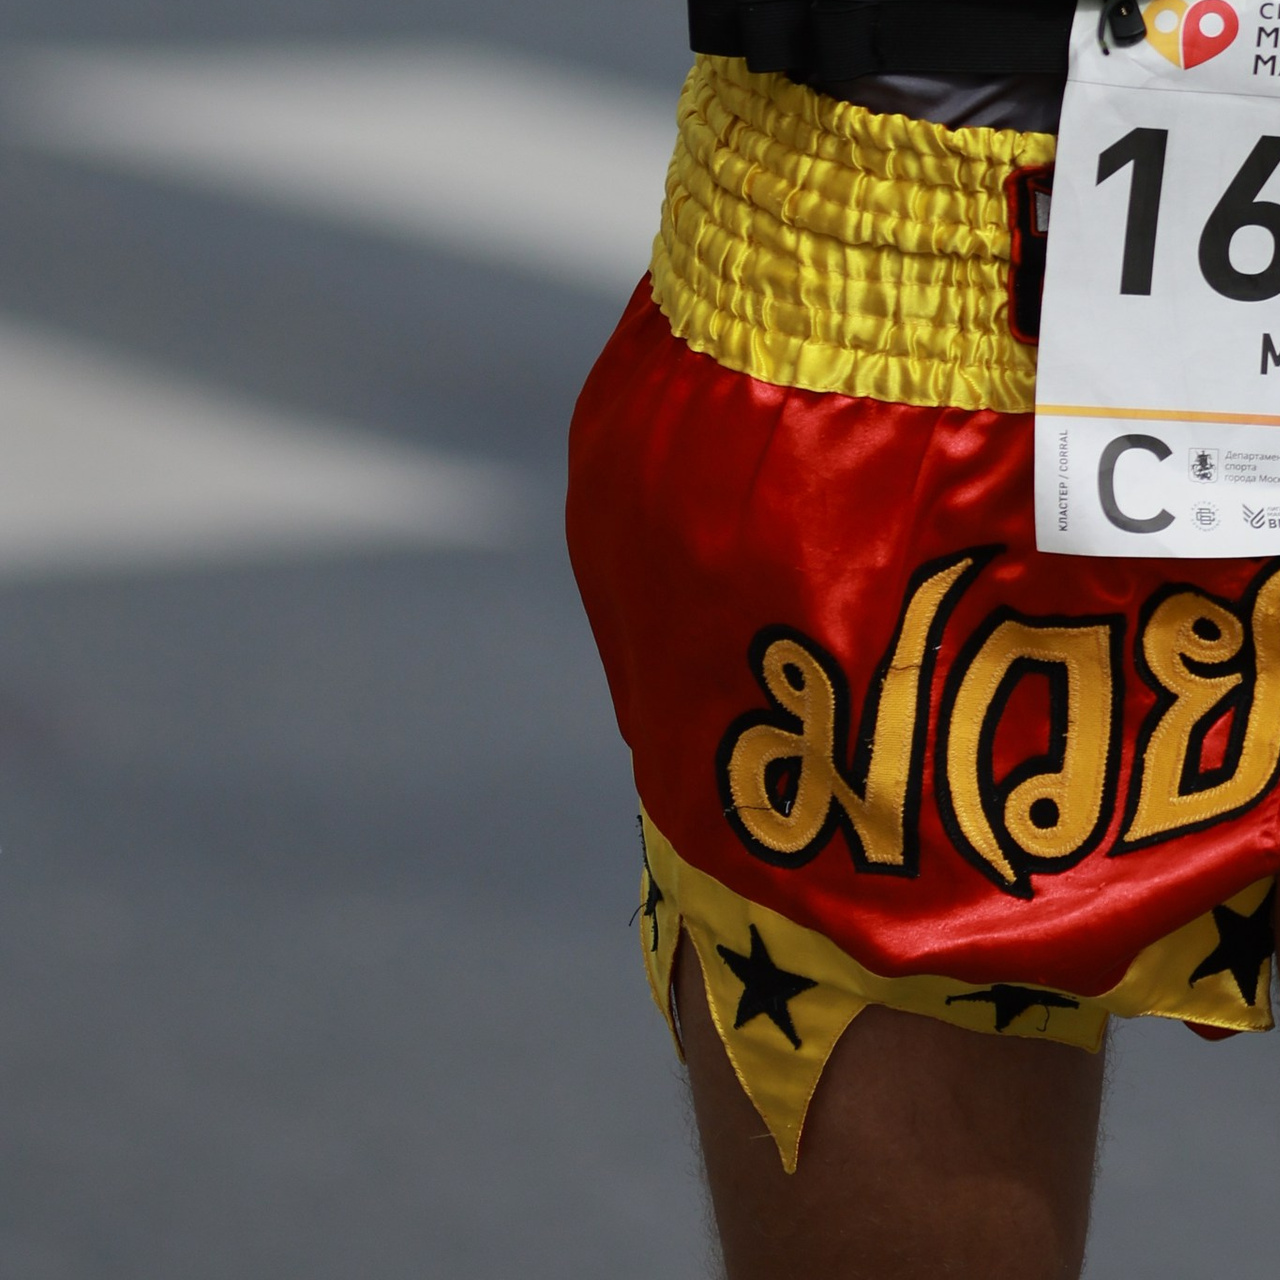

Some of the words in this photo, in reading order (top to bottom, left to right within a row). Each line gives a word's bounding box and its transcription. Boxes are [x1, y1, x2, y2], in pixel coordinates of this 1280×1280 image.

[1059, 429, 1068, 472] CORRAL
[1225, 463, 1257, 473] спорта
[1225, 474, 1257, 484] города
[1059, 481, 1068, 532] КЛАСТЕР
